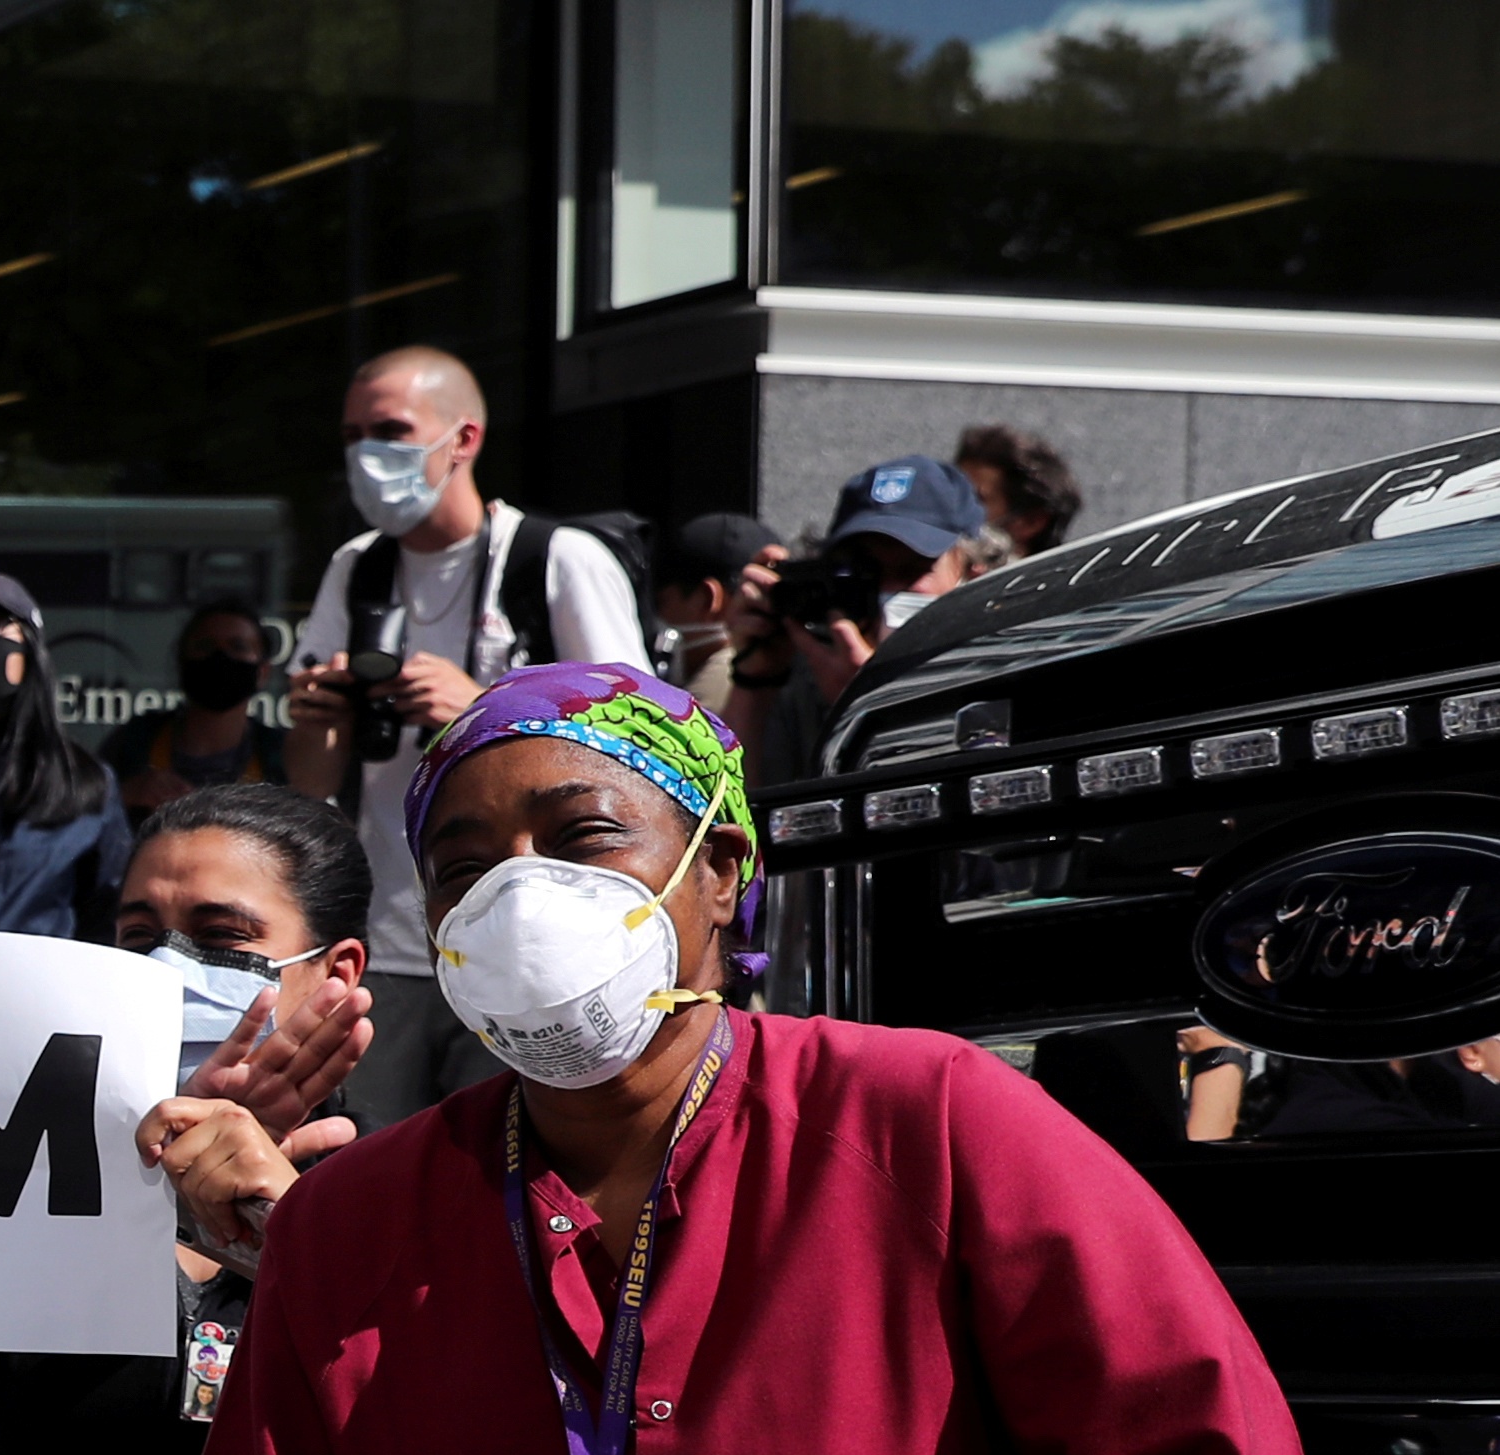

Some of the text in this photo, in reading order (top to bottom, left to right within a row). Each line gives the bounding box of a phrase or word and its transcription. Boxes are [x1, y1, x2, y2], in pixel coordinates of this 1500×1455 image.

[1255, 866, 1471, 983] Ford
[532, 1023, 563, 1039] 8210
[587, 1002, 615, 1033] N95
[616, 1200, 654, 1414] 1199SEIU QUALITY CARE AND
[605, 1316, 628, 1411] GOOD JOBS FOR ALL
